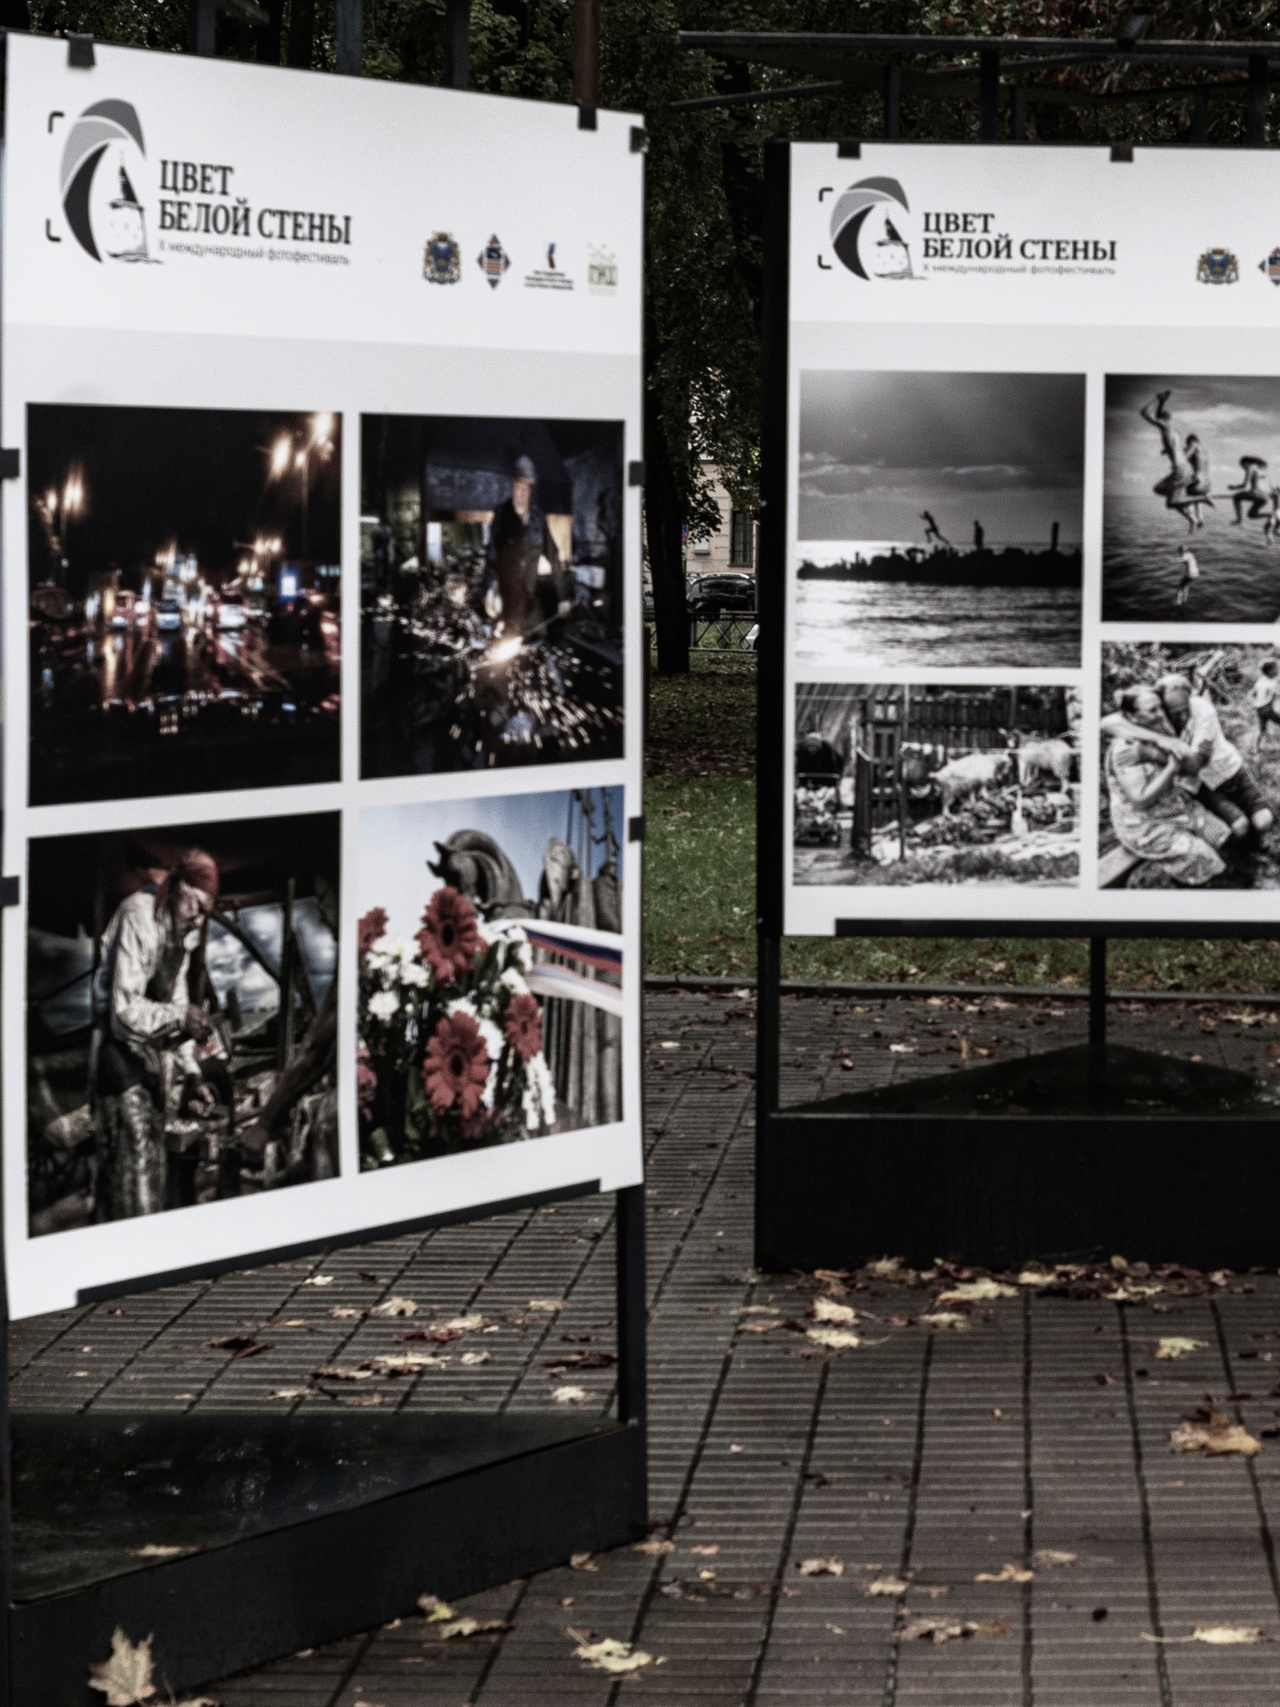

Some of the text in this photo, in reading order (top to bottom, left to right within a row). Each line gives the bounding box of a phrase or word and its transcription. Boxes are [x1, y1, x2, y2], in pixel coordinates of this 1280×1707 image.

[160, 159, 234, 196] ЦВЕТ
[159, 197, 353, 245] БЕЛОЙ СТЕНЫ
[923, 212, 995, 236] ЦВЕТ
[169, 241, 264, 259] международный
[268, 248, 350, 266] фотофестиваль
[923, 233, 1117, 261] БЕЛОЙ СТЕНЫ
[932, 264, 1027, 275] международный
[1031, 263, 1117, 275] фотофестиваль
